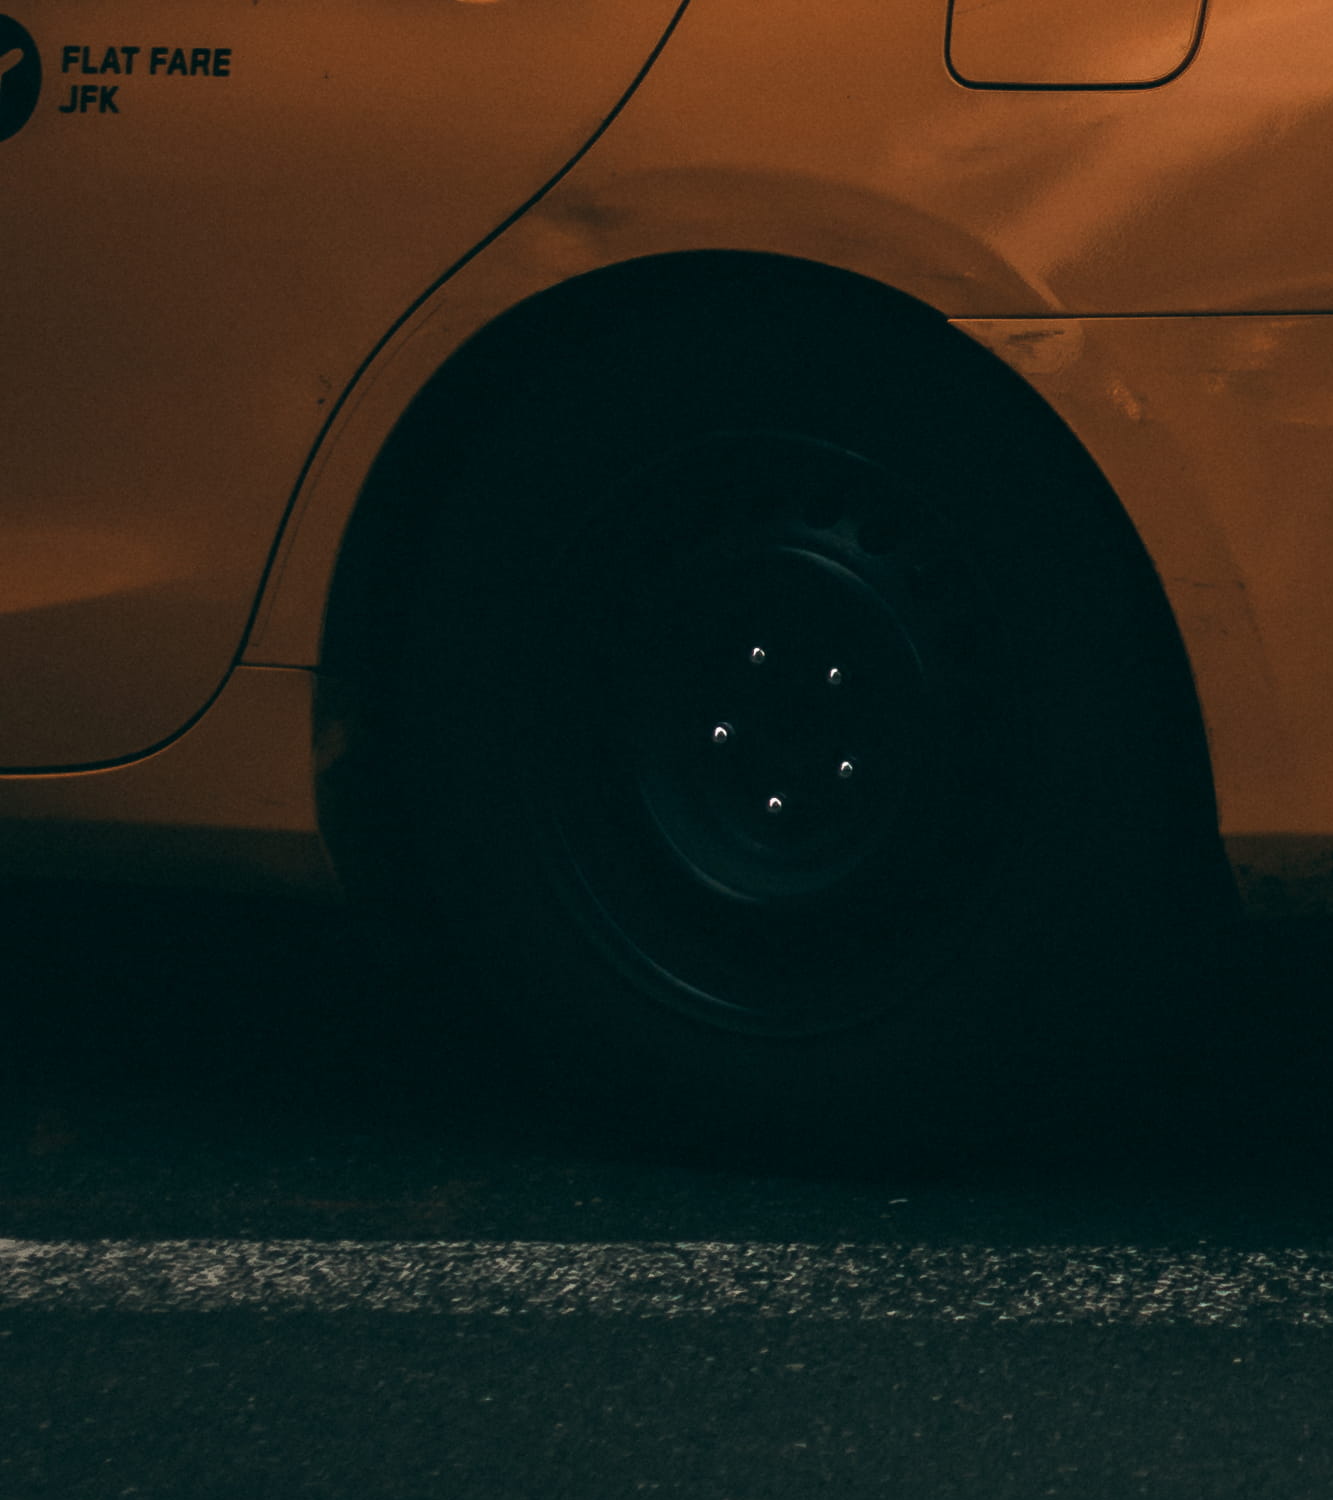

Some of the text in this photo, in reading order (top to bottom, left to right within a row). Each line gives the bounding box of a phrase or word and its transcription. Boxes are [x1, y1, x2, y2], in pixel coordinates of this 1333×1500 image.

[61, 45, 233, 78] FLAT FARE
[57, 85, 120, 114] JFK
